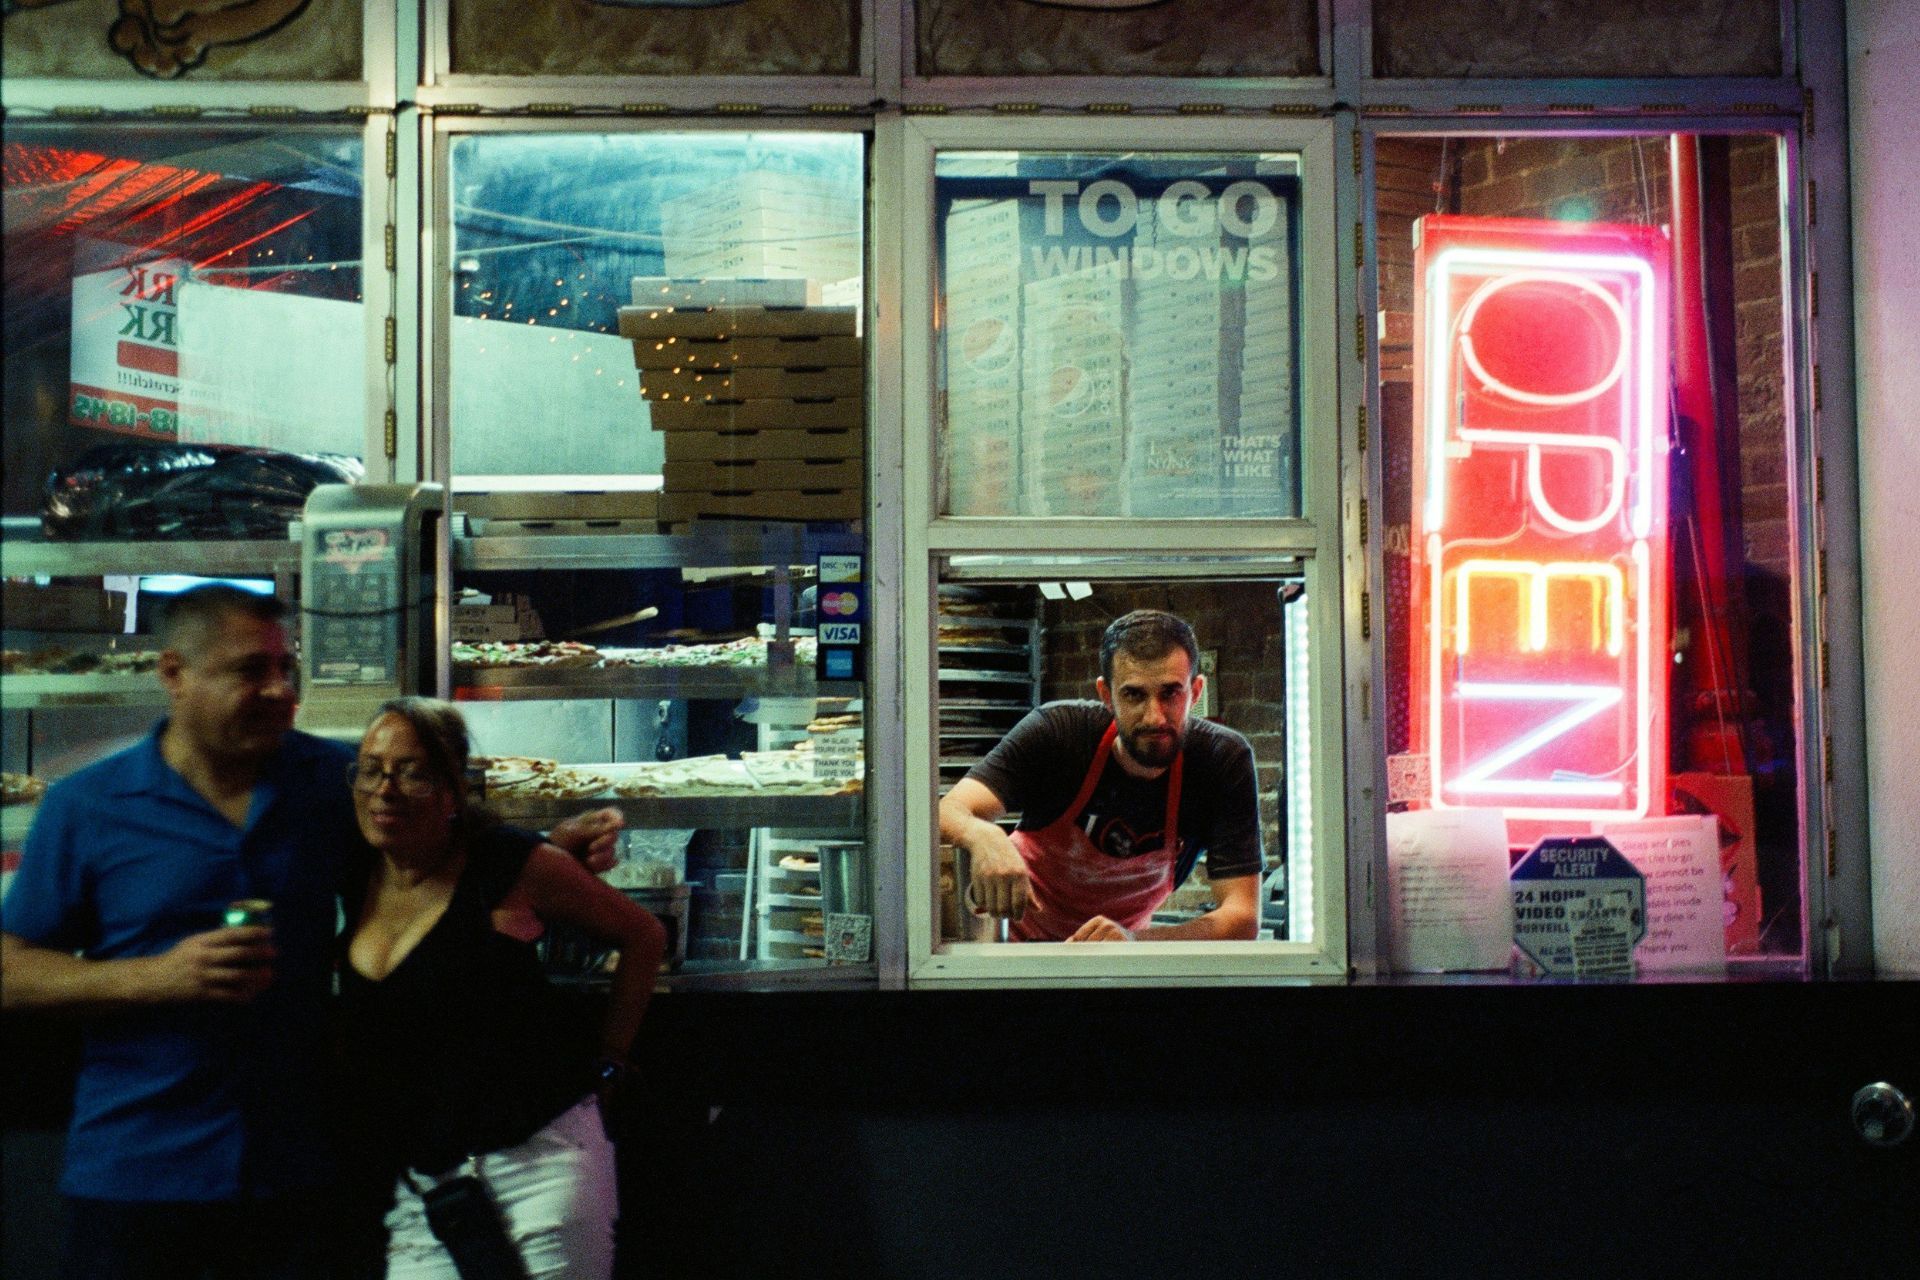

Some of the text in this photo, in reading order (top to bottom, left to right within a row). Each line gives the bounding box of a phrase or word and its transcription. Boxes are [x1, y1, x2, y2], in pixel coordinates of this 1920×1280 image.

[1029, 179, 1279, 238] TO GO
[1031, 245, 1279, 281] WINDOWS
[1223, 435, 1282, 449] THAT'S
[1224, 450, 1274, 463] WHAT
[1234, 464, 1273, 478] LIKE
[1446, 270, 1630, 795] OPEN
[824, 627, 859, 641] VISA
[1539, 847, 1609, 863] SECURITY
[1552, 862, 1598, 878] ALERT
[1514, 890, 1534, 904] 24
[1514, 906, 1566, 919] VIDEO
[1514, 923, 1571, 934] SURVEILL
